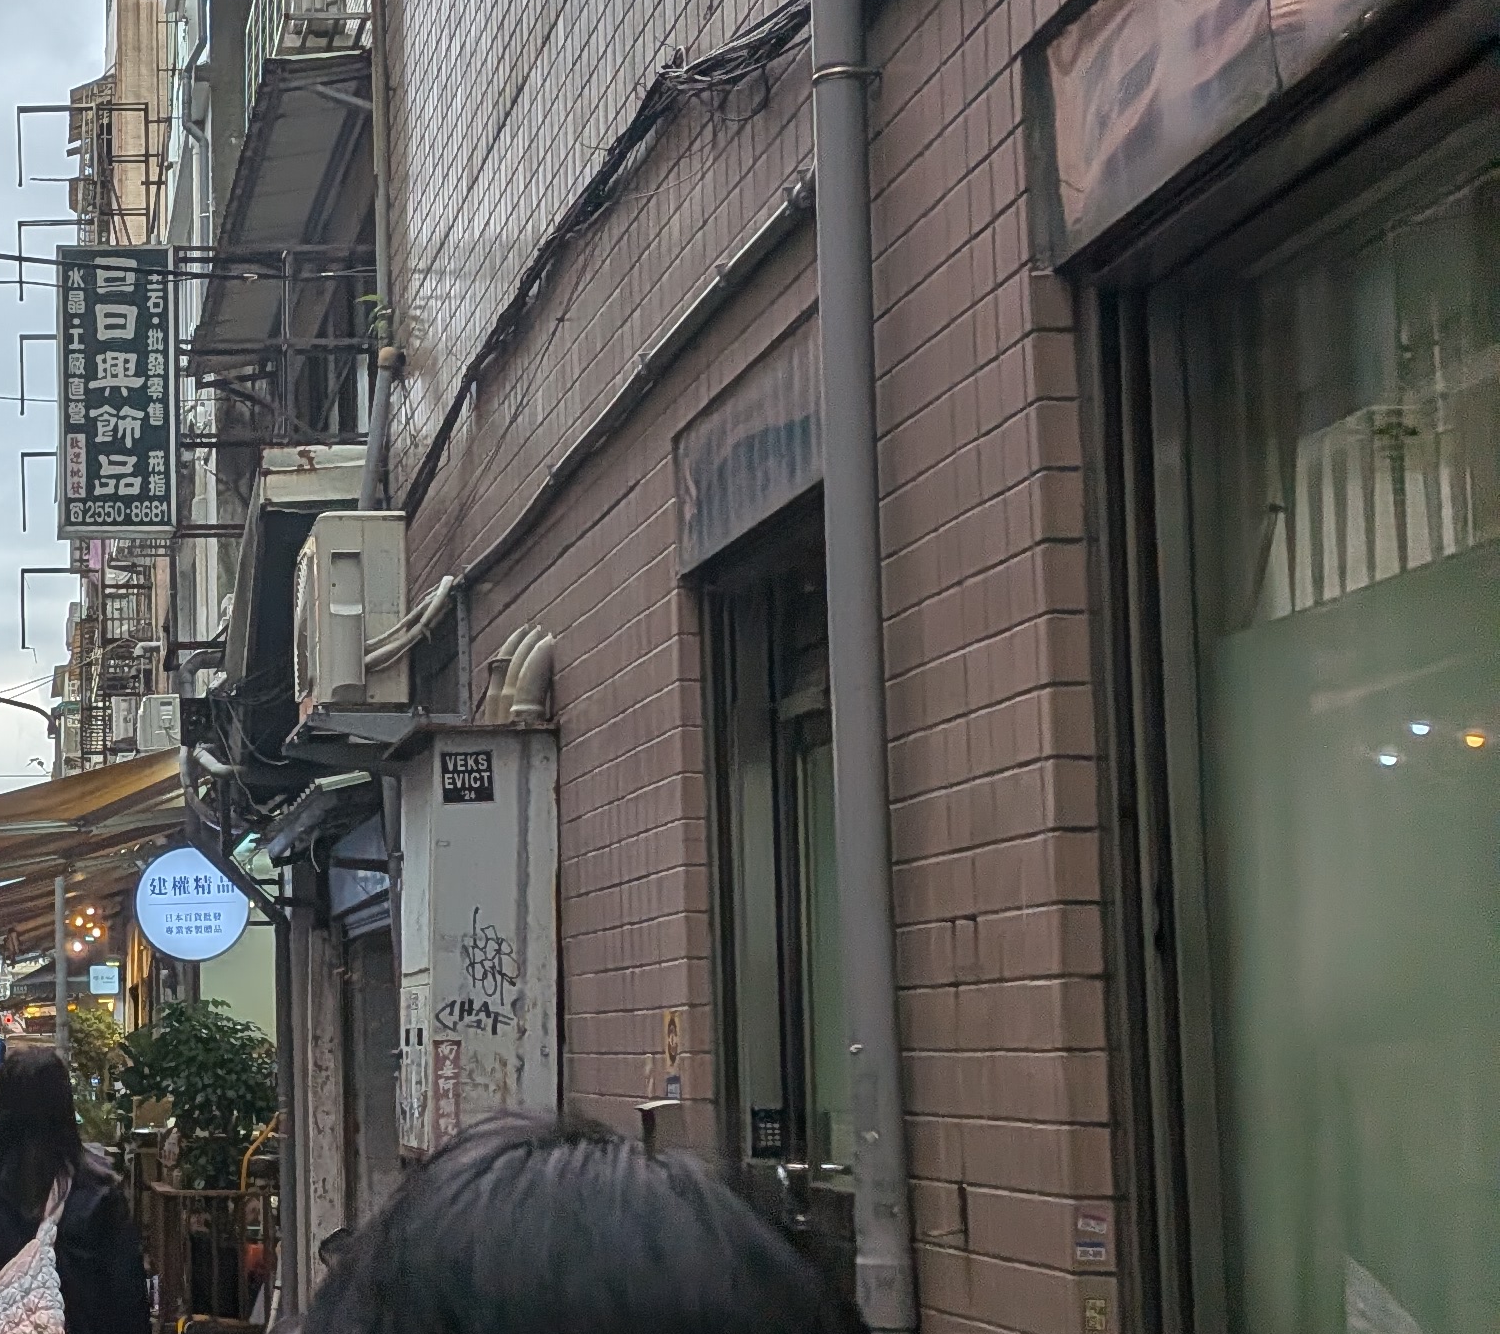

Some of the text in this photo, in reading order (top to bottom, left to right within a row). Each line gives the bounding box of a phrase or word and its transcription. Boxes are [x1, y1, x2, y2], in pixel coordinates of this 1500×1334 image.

[147, 450, 165, 496] 戒指
[445, 753, 488, 772] VEKS
[444, 771, 491, 789] EVICT
[149, 874, 236, 897] 建權精品
[436, 1041, 459, 1143] 南無阿彌陀
